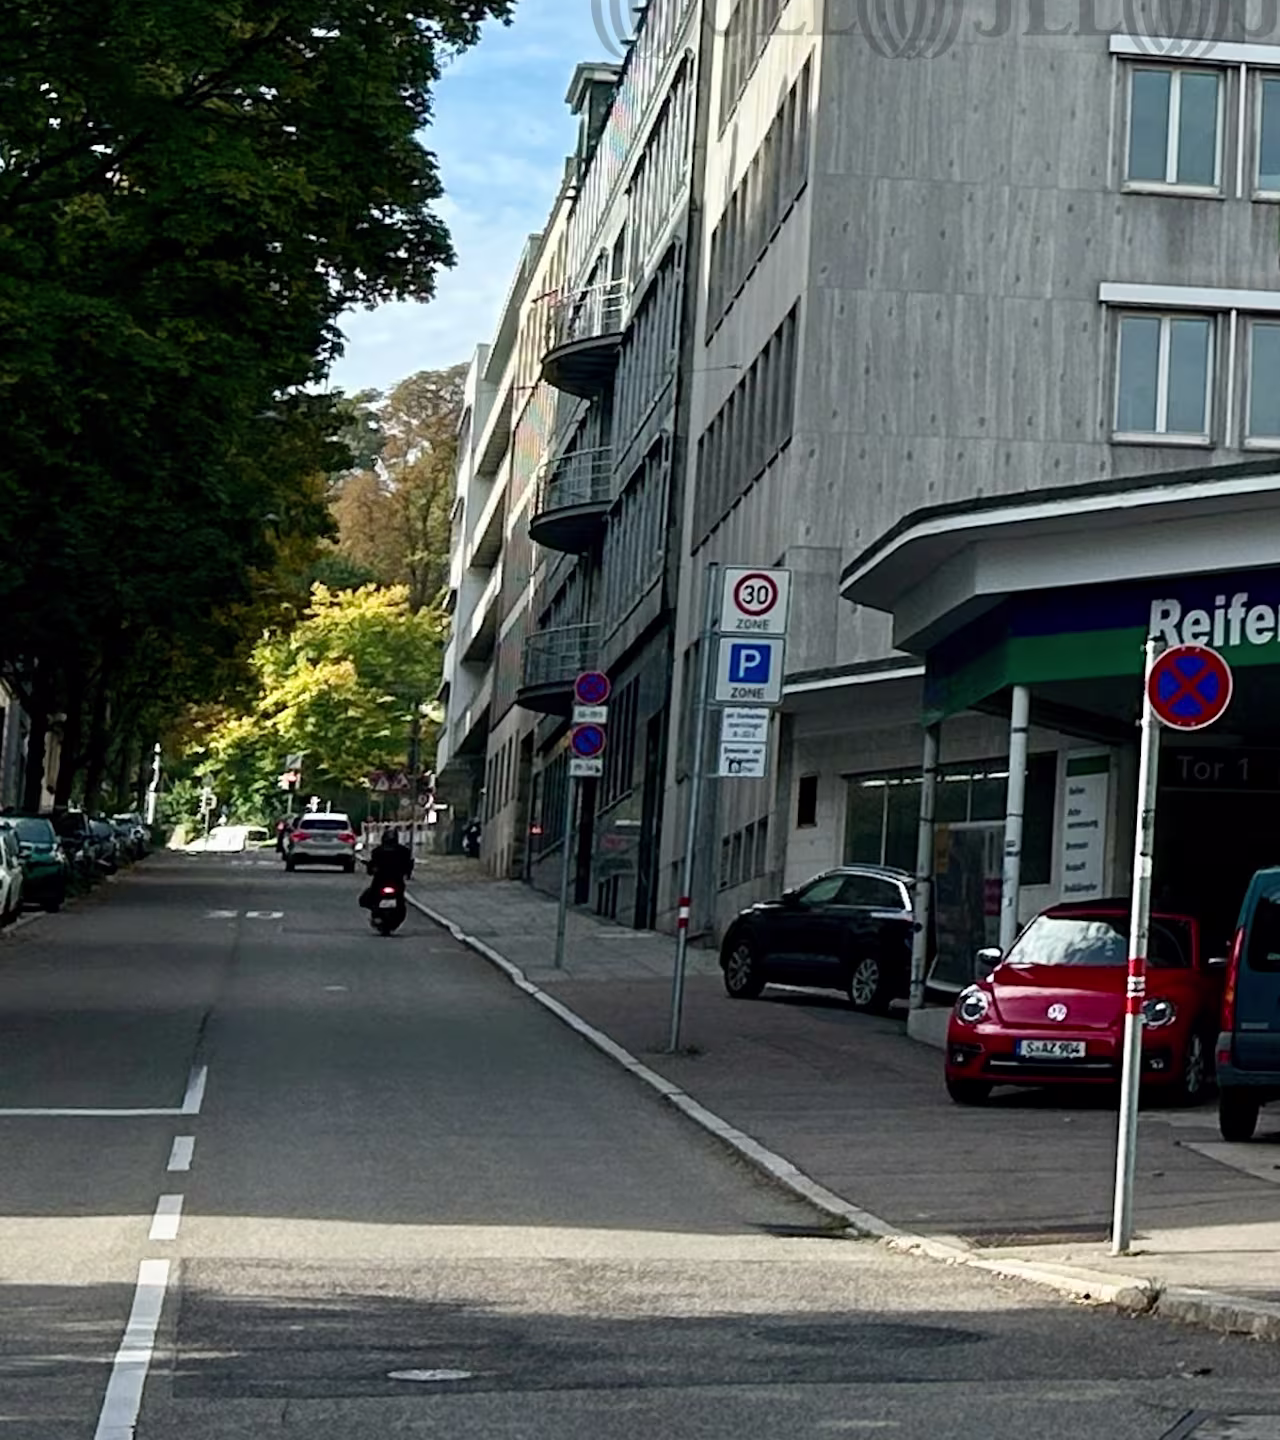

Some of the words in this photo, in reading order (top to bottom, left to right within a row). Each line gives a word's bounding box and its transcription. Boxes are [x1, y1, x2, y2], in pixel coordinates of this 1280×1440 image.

[741, 585, 769, 606] 30
[735, 618, 771, 631] ZONE
[739, 648, 761, 678] P
[730, 686, 765, 699] ZONE
[1177, 755, 1225, 781] Tor
[1238, 757, 1249, 781] 1
